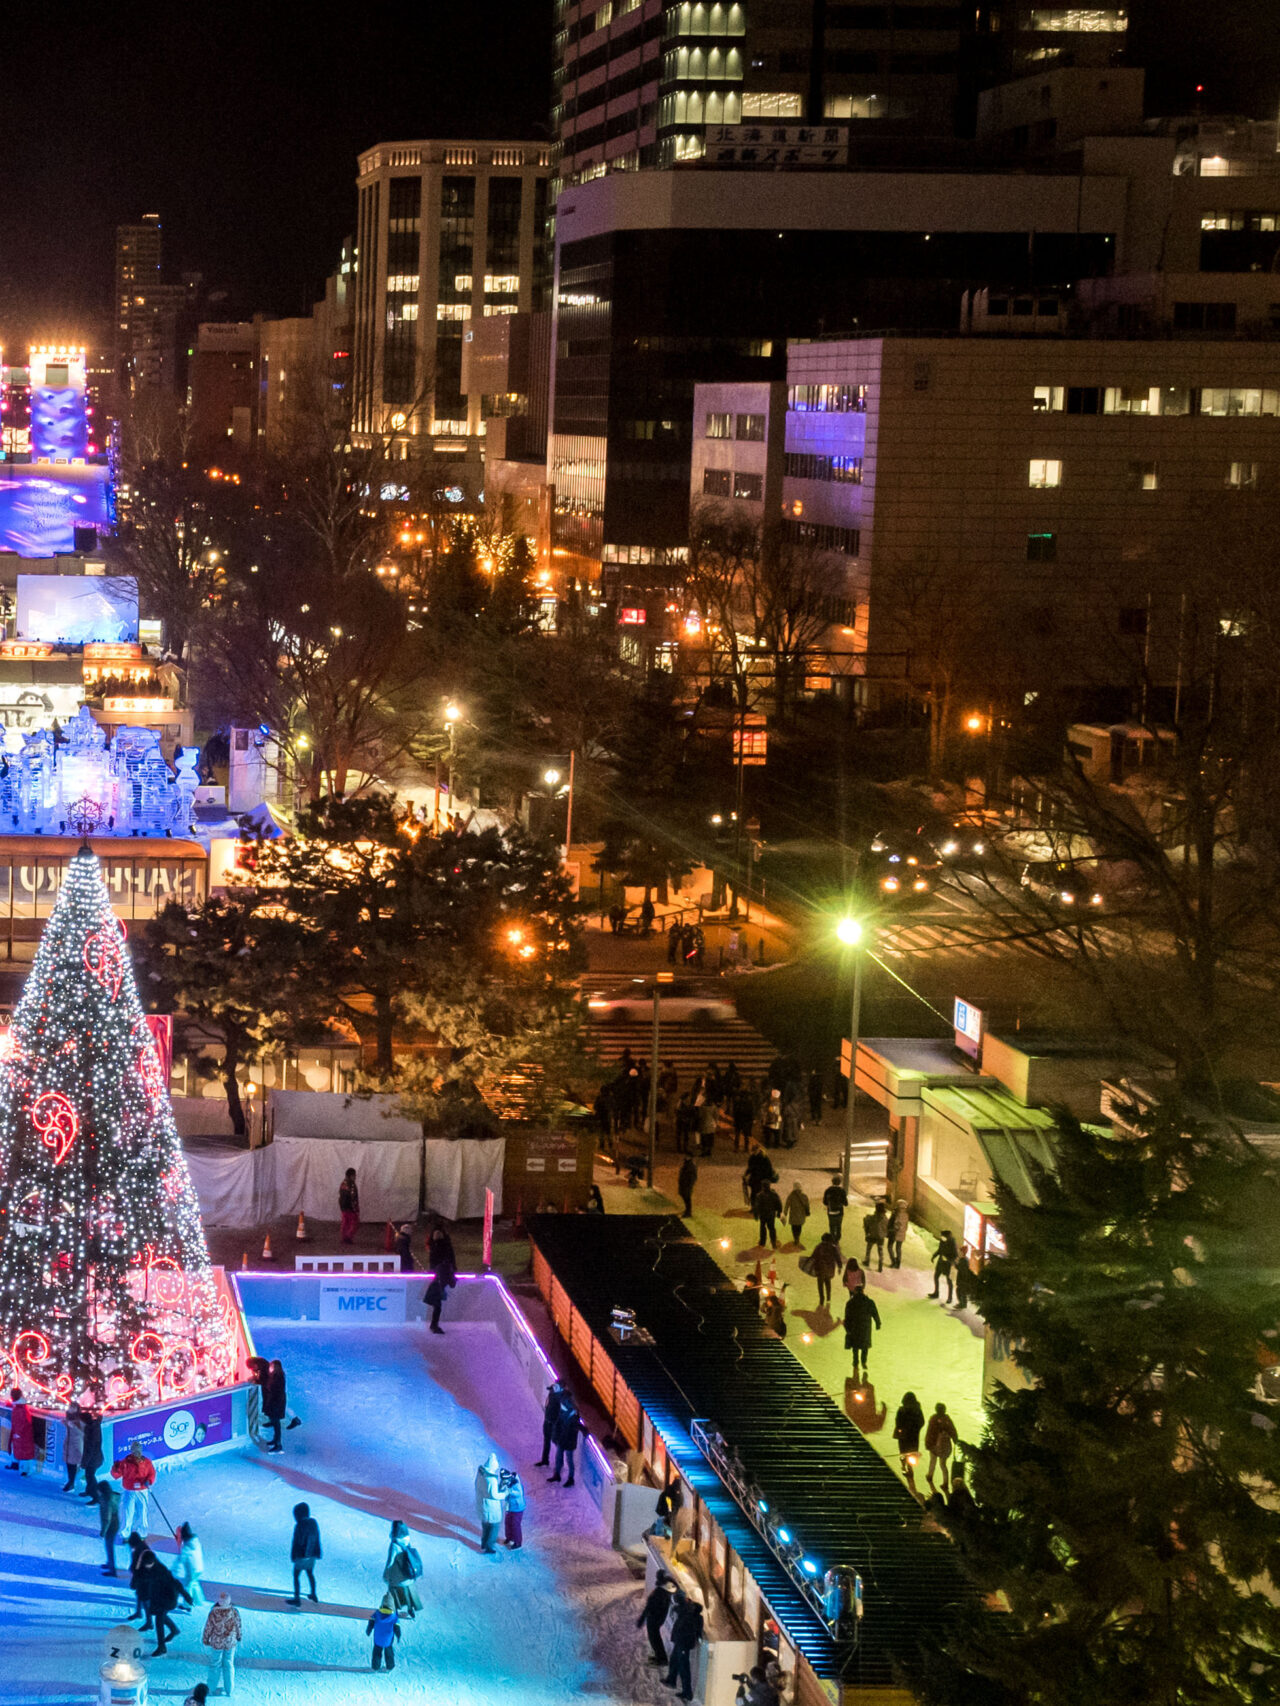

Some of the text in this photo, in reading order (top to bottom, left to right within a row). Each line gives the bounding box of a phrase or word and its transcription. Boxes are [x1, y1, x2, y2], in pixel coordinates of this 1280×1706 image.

[716, 127, 840, 144] 北海道新聞
[338, 1296, 387, 1311] MPEC
